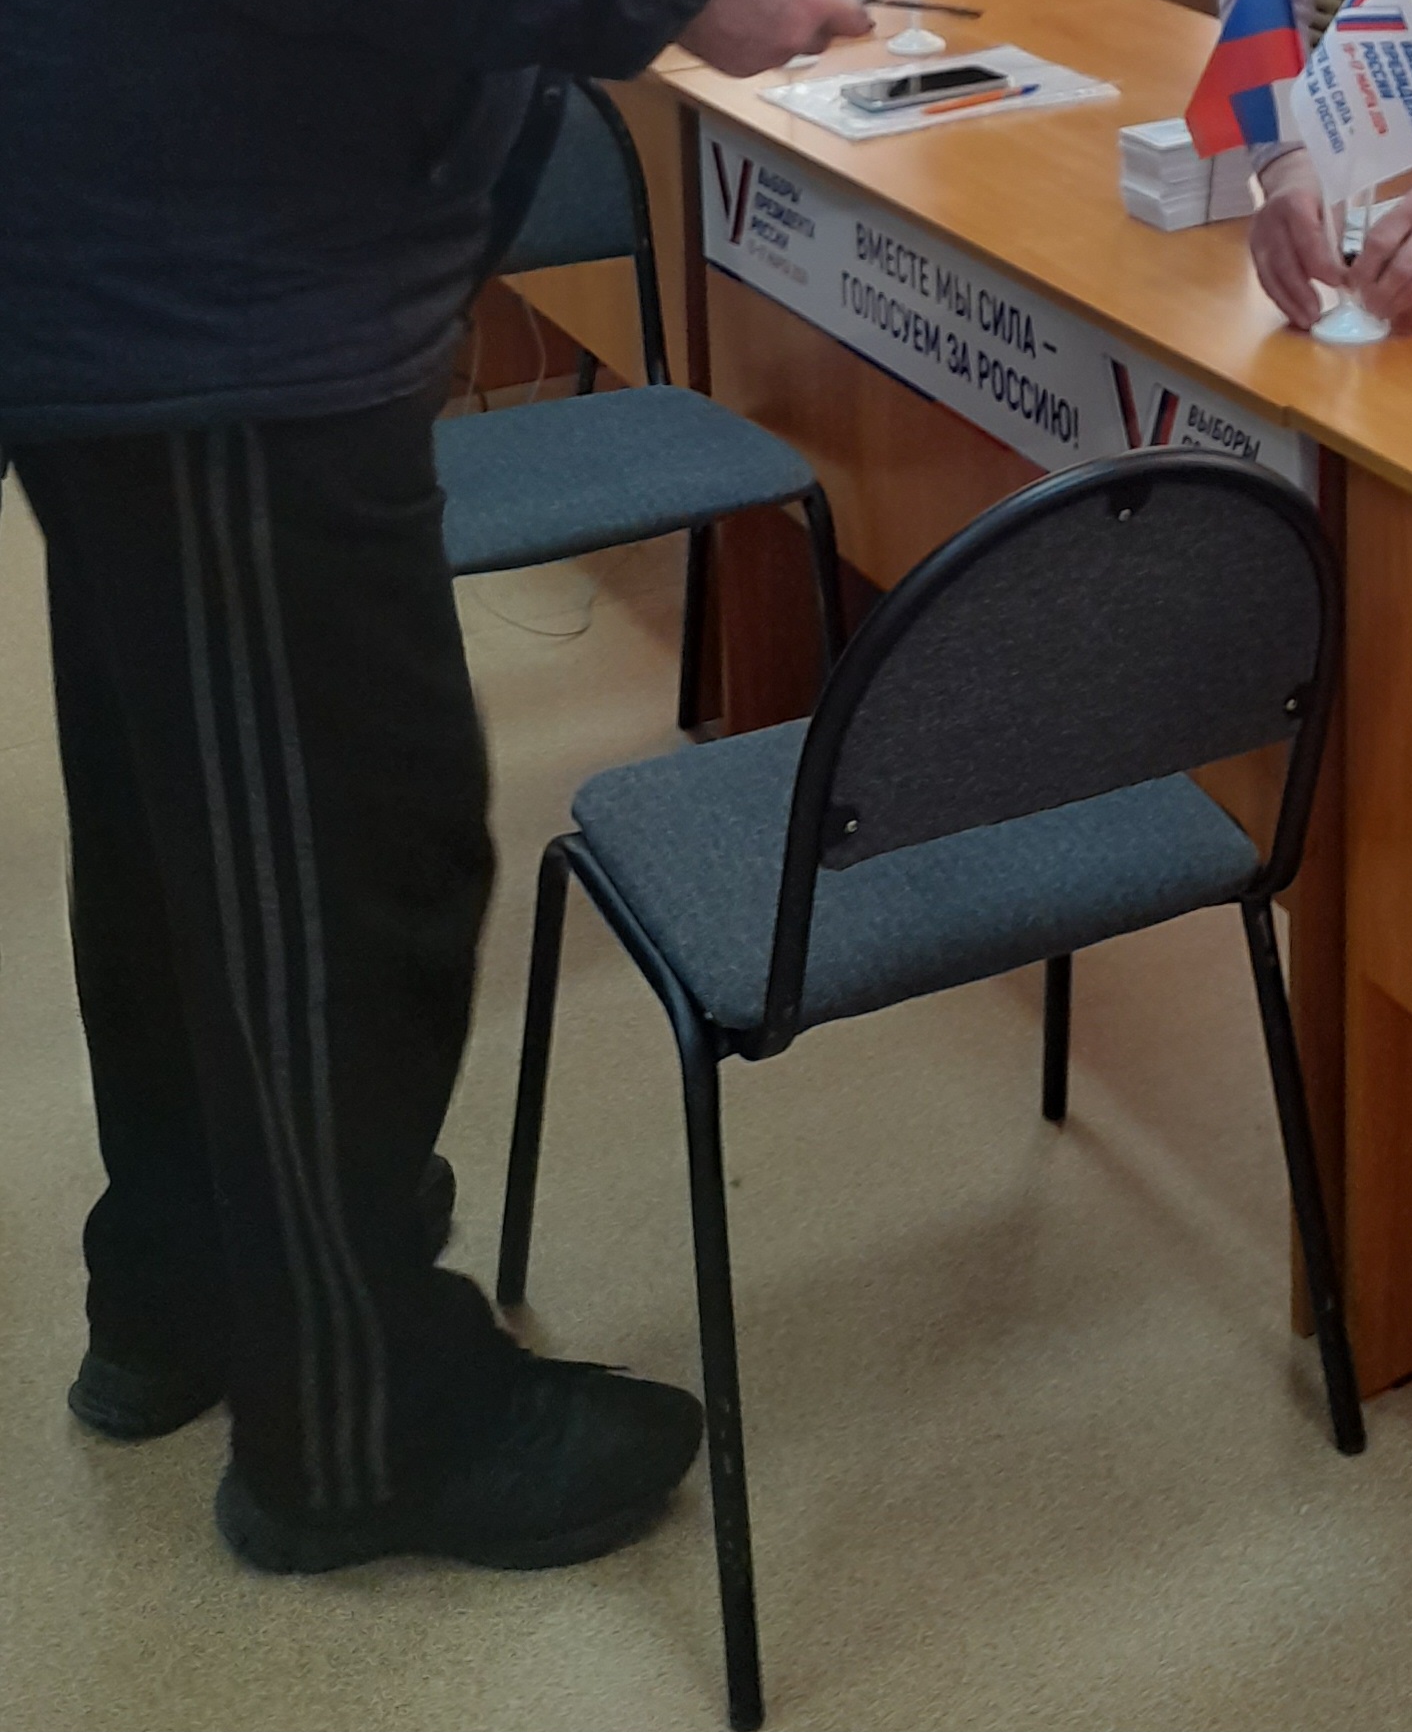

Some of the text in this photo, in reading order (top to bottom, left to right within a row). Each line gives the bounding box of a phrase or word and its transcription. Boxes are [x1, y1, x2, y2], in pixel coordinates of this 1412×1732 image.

[857, 221, 929, 297] ВМЕСТЕ
[936, 265, 971, 322] МЫ
[979, 289, 1036, 359] СИЛА
[841, 270, 1079, 450] ГОЛОСУЕМ ЗА РОССИЮ!
[1187, 404, 1261, 463] ВЫБОРЫ
